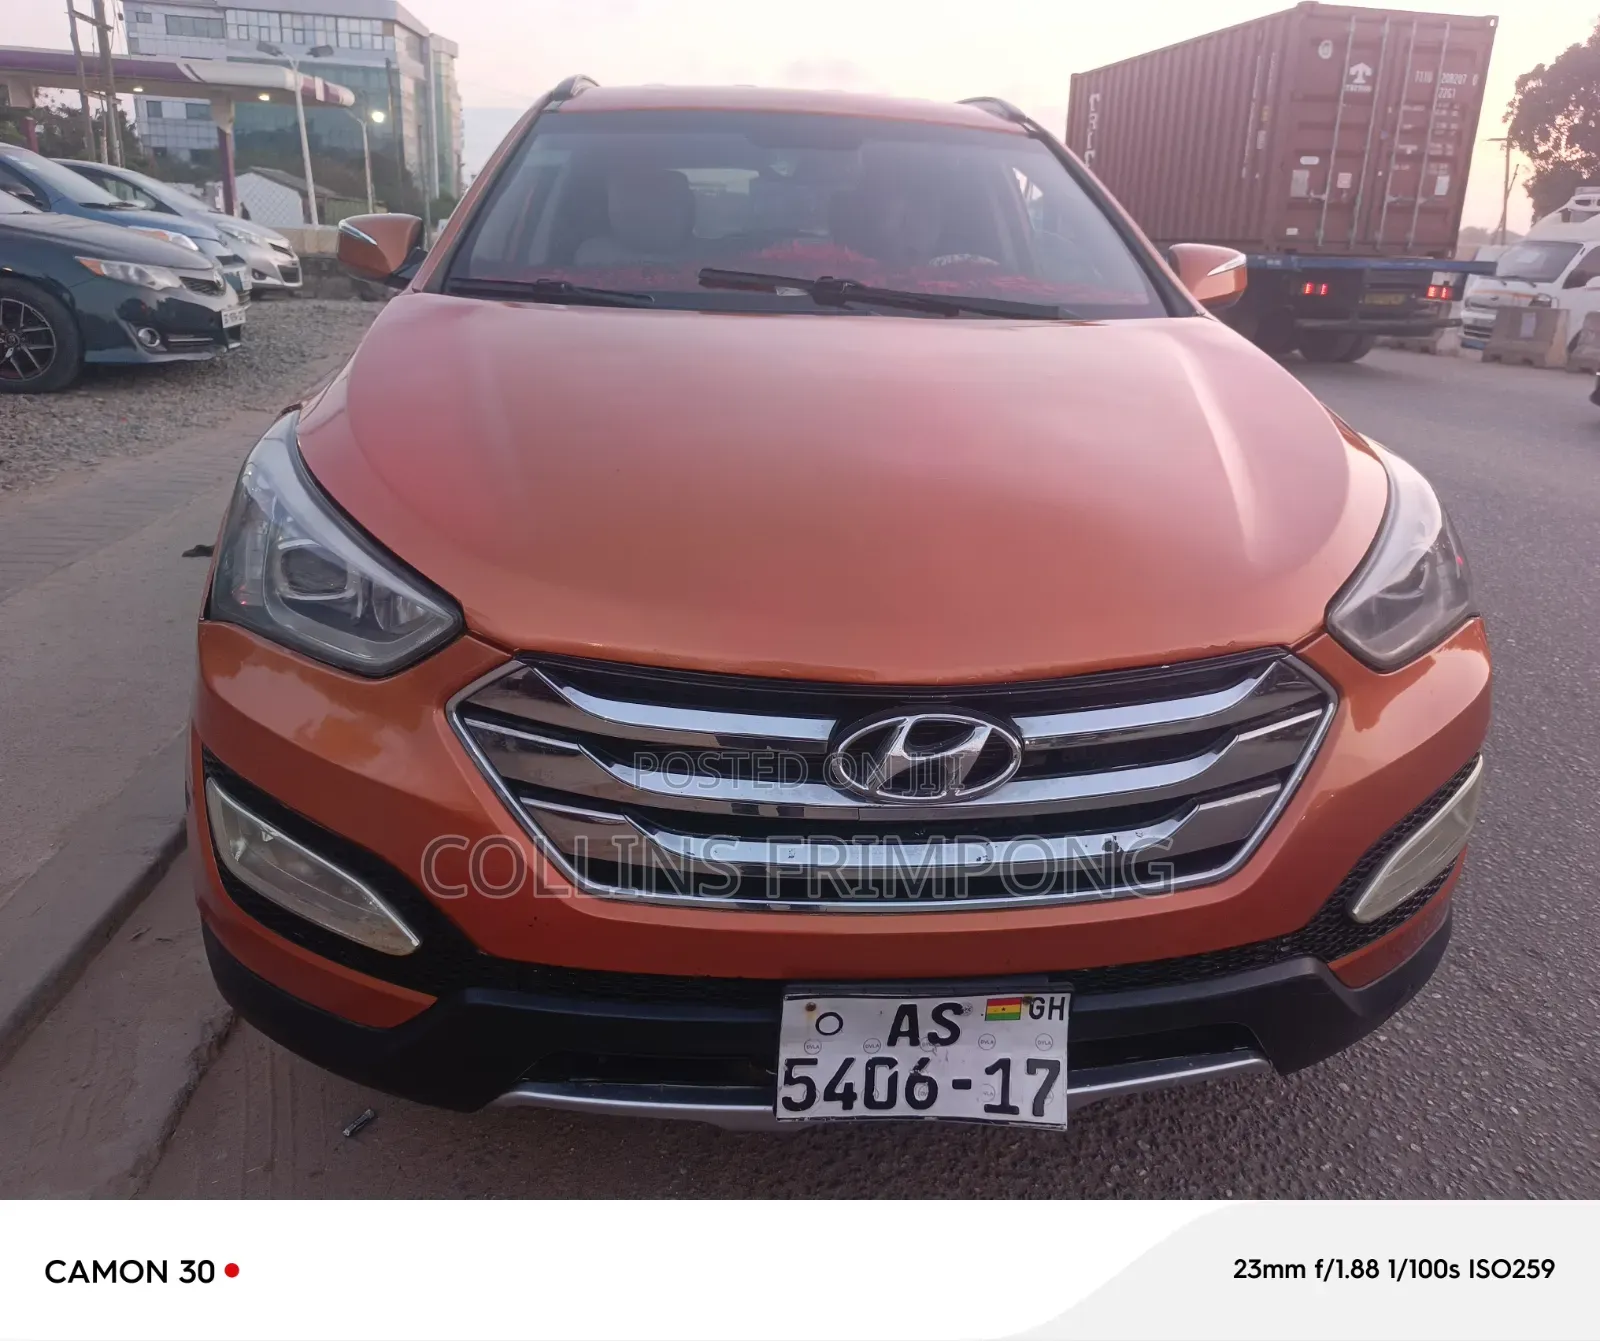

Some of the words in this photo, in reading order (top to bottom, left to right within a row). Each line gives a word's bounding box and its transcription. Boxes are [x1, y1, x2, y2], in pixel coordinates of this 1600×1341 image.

[887, 1002, 963, 1047] AS
[1028, 997, 1067, 1021] GH
[781, 1057, 1061, 1117] 5406-17
